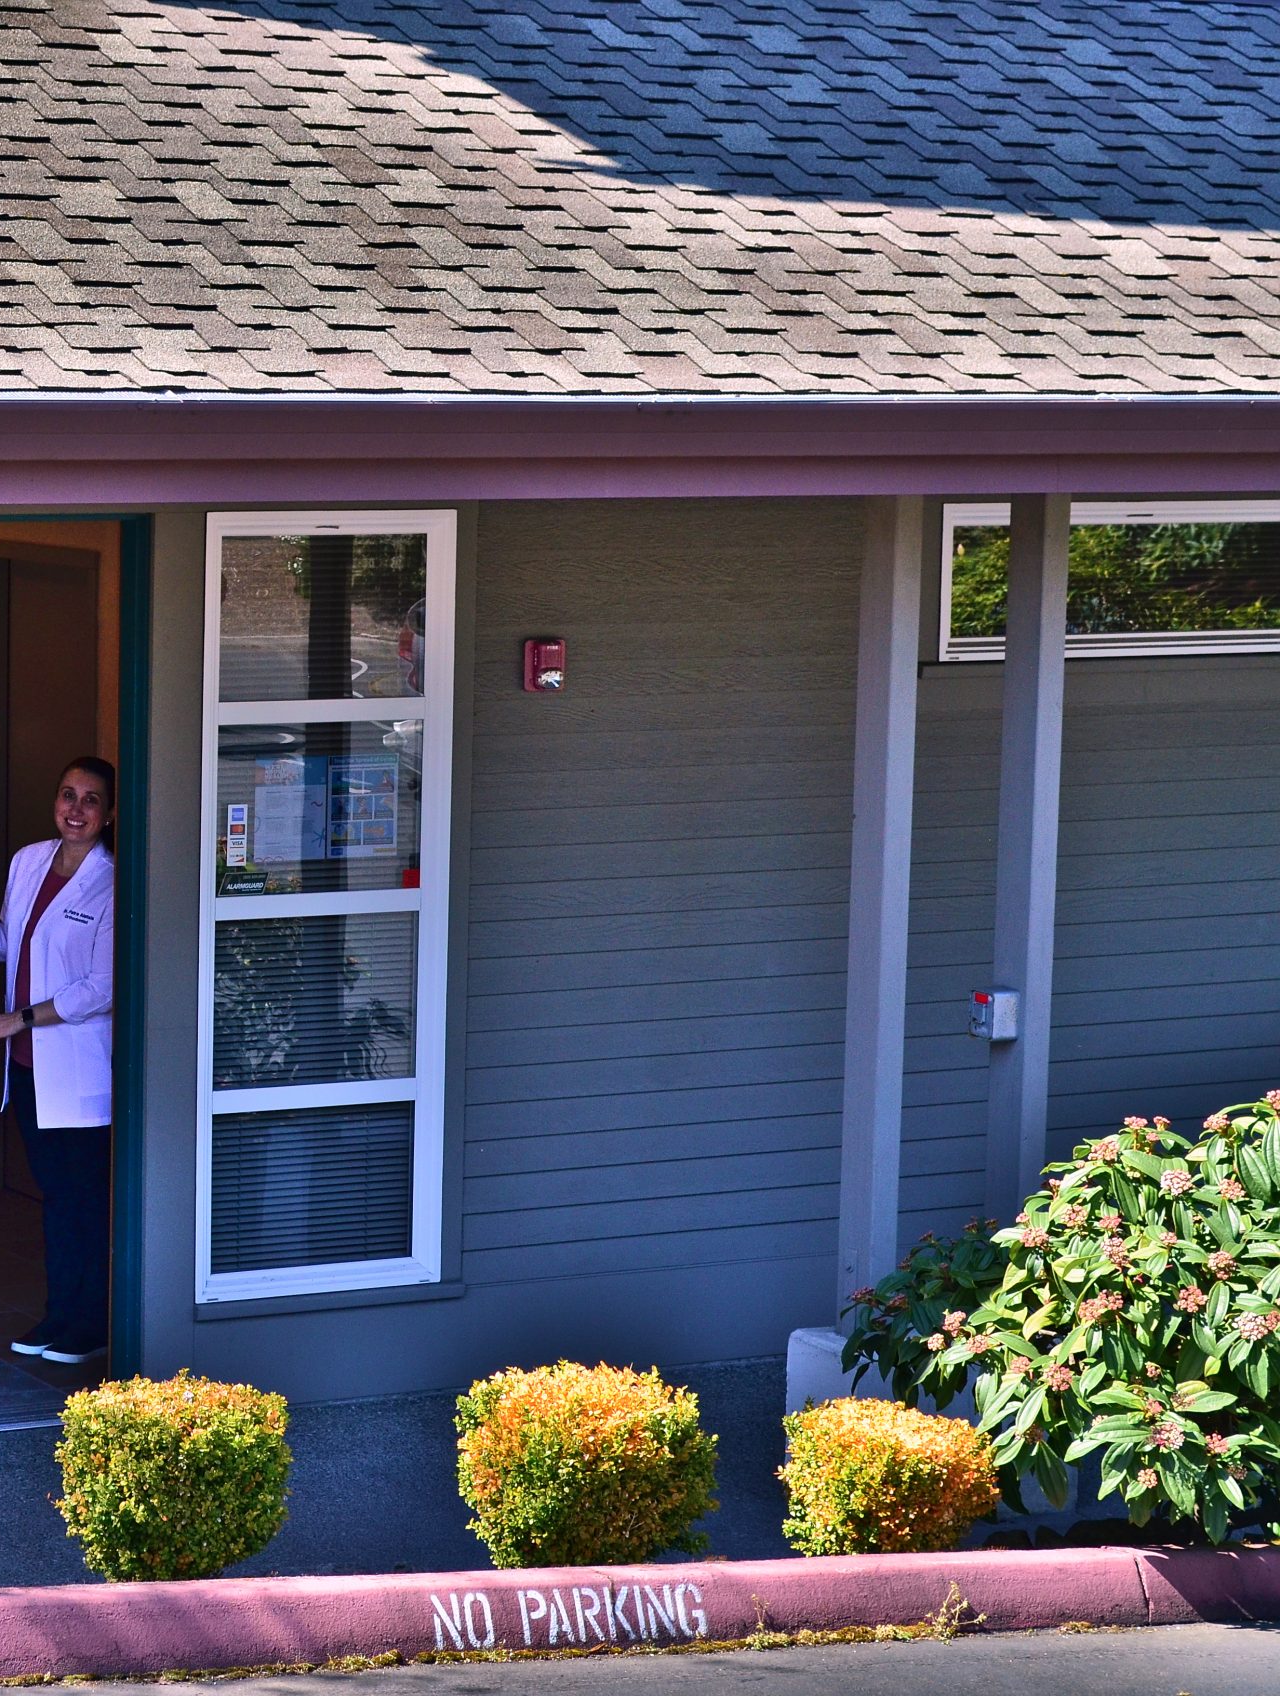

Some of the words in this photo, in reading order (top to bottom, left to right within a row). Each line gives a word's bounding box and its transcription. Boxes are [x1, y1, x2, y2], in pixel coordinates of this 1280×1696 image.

[226, 882, 264, 890] ALARMGUARD
[430, 1592, 495, 1651] NO
[517, 1582, 709, 1646] PARKING
